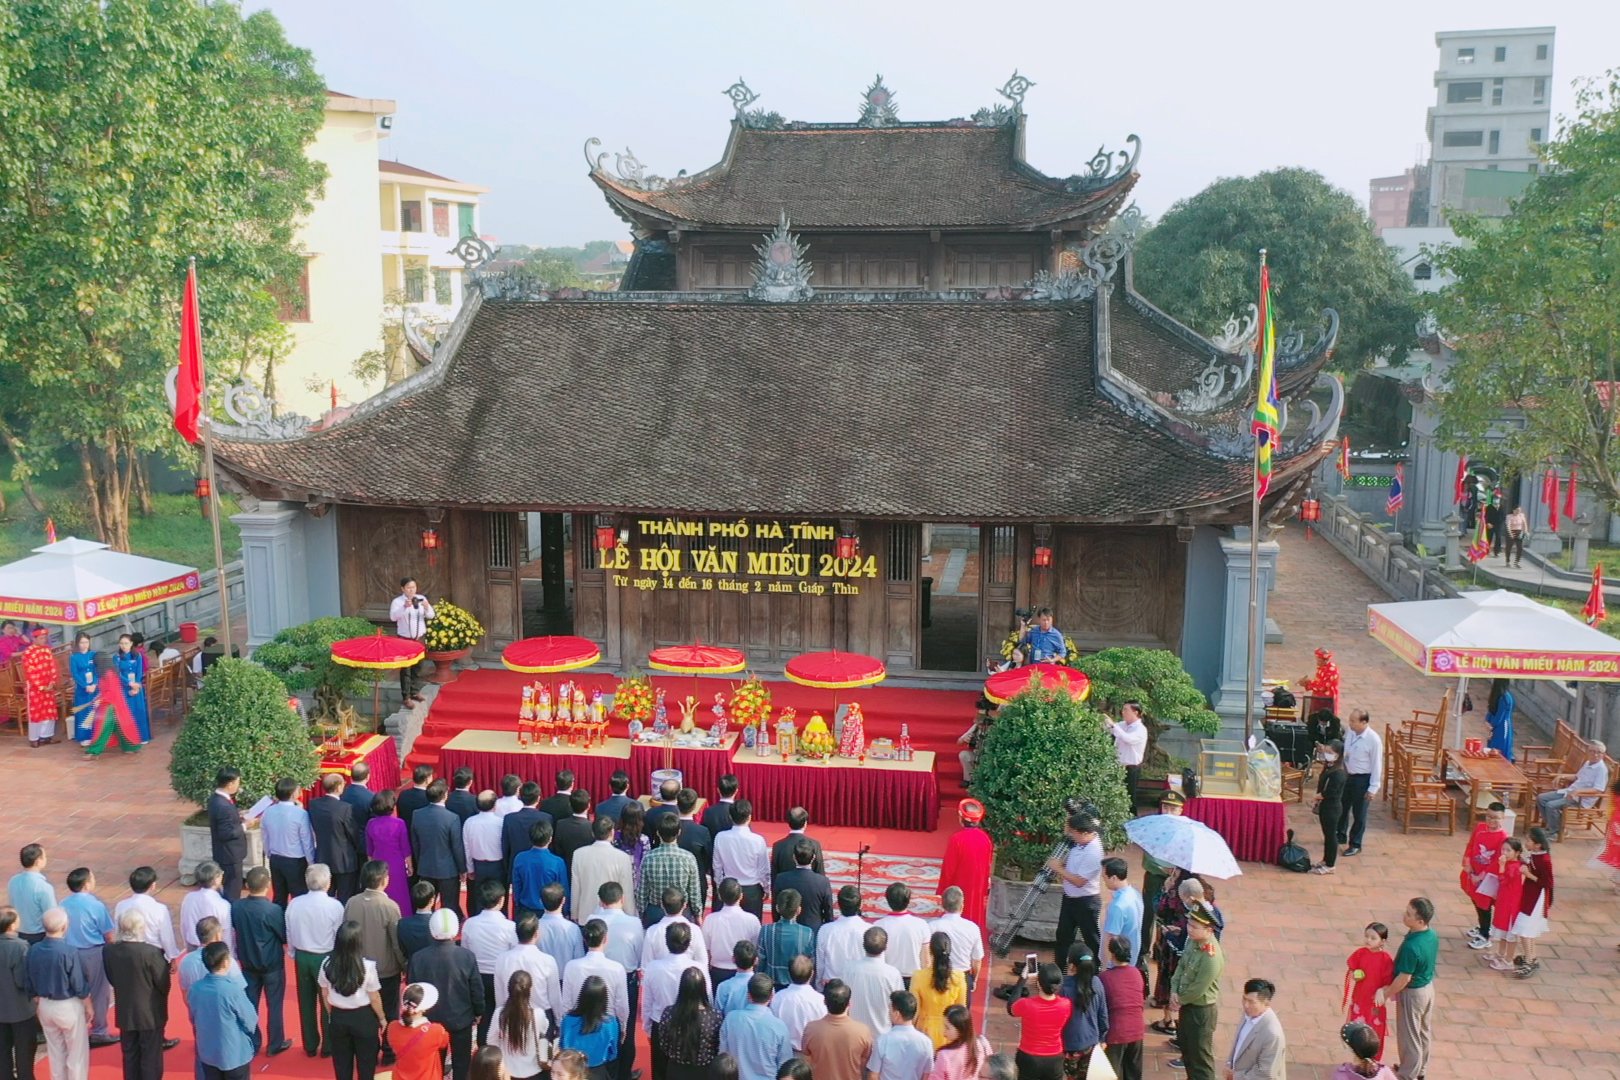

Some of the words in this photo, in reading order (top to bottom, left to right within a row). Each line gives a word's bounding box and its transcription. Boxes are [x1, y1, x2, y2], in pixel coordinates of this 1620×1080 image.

[638, 518, 703, 536] THÀNH
[709, 518, 749, 538] PHỐ
[756, 521, 784, 539] HÀ
[790, 522, 834, 540] TĨNH
[599, 538, 631, 570] LỄ
[640, 542, 680, 577] HỘI
[691, 545, 738, 574] VĂN
[747, 543, 810, 576] MIẾU
[820, 554, 877, 578] 2024
[634, 577, 658, 591] ngày
[663, 577, 674, 588] 14
[679, 576, 697, 589] đến
[702, 579, 713, 590] 16
[719, 579, 749, 594] tháng
[755, 581, 762, 592] 2
[768, 582, 793, 593] năm
[799, 581, 825, 595] Giáp
[832, 582, 859, 595] Thìn
[1495, 655, 1519, 670] VĂN
[1523, 655, 1552, 671] MIẾU
[1556, 658, 1585, 671] NĂM
[1588, 660, 1618, 673] 2024
